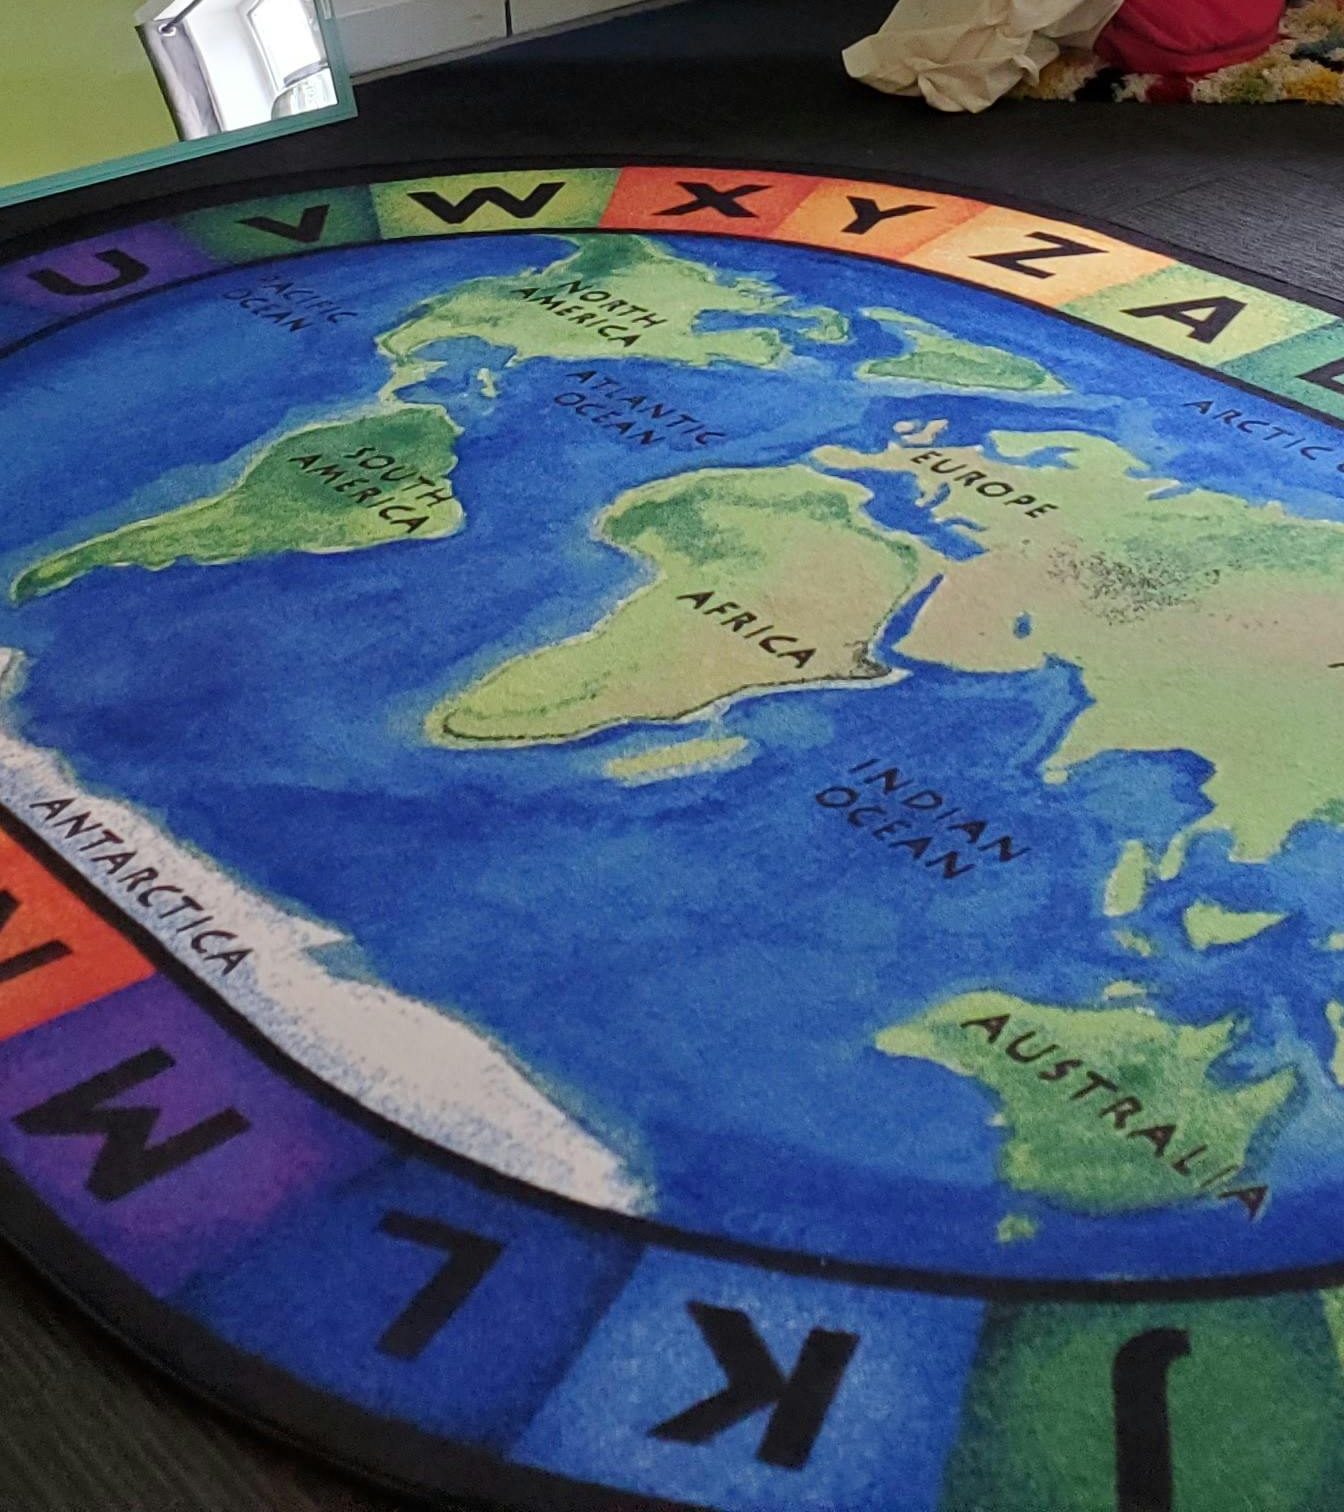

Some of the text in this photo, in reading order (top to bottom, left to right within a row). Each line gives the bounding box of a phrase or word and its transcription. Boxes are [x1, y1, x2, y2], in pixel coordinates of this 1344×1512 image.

[238, 204, 330, 243] V
[406, 181, 566, 225] W
[652, 181, 772, 218] X
[838, 196, 936, 235] Y
[26, 249, 149, 296] U
[968, 231, 1108, 279] Z
[222, 289, 312, 333] OCEAN
[260, 272, 358, 325] PACIFIC
[515, 287, 642, 349] AMERICA
[556, 278, 669, 330] NORTH
[1120, 295, 1248, 344] A
[553, 391, 666, 448] OCEAN
[565, 369, 727, 447] ATLANTIC
[1182, 400, 1334, 460] ARCTIC
[289, 452, 431, 535] AMERICA
[342, 445, 455, 506] SOUTH
[910, 449, 1058, 519] EUROPE
[676, 590, 816, 669] AFRICA
[815, 786, 975, 880] OCEAN
[848, 758, 1029, 864] INDIAN
[29, 796, 255, 976] ANTARCTICA
[10, 1046, 253, 1203] M
[960, 1013, 1269, 1220] AUSTRALIA
[374, 1210, 506, 1361] L
[646, 1300, 860, 1472] K
[1111, 1327, 1192, 1512] J
